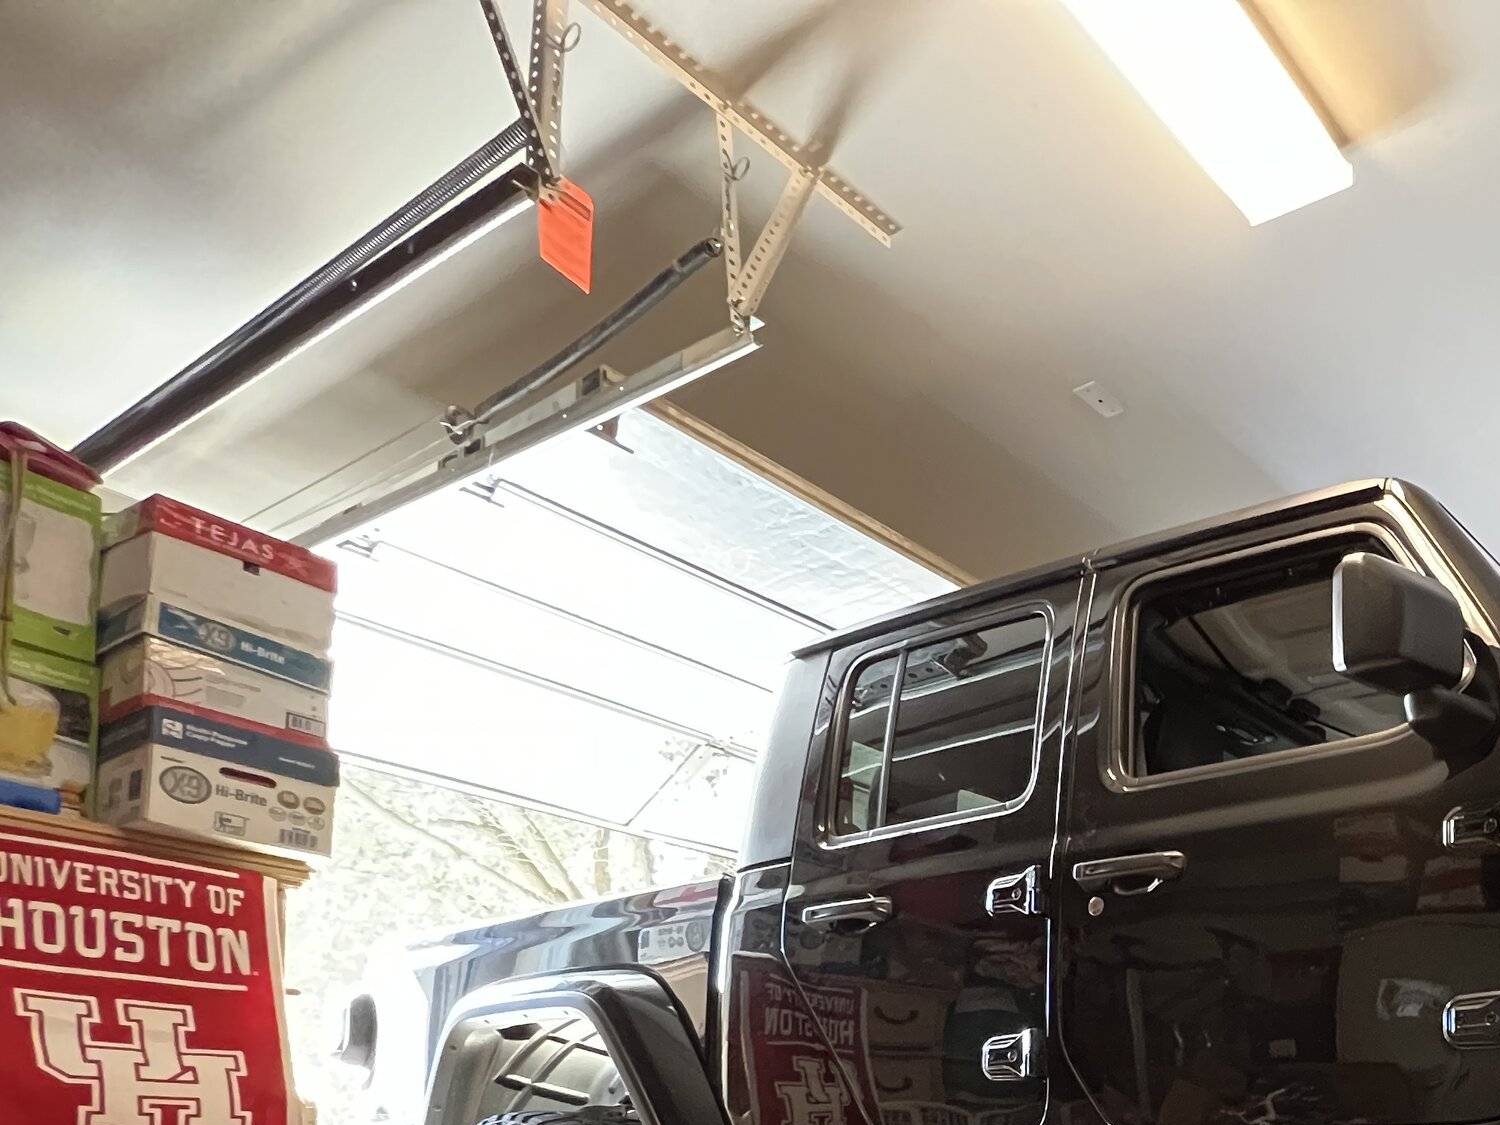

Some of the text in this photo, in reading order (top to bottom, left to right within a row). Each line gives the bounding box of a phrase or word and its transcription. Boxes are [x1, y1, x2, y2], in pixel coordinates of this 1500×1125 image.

[191, 516, 275, 561] TEJAS
[215, 784, 267, 807] Hi-Brite
[0, 853, 245, 917] NIVERSITY OF
[0, 898, 251, 976] HOUSTON
